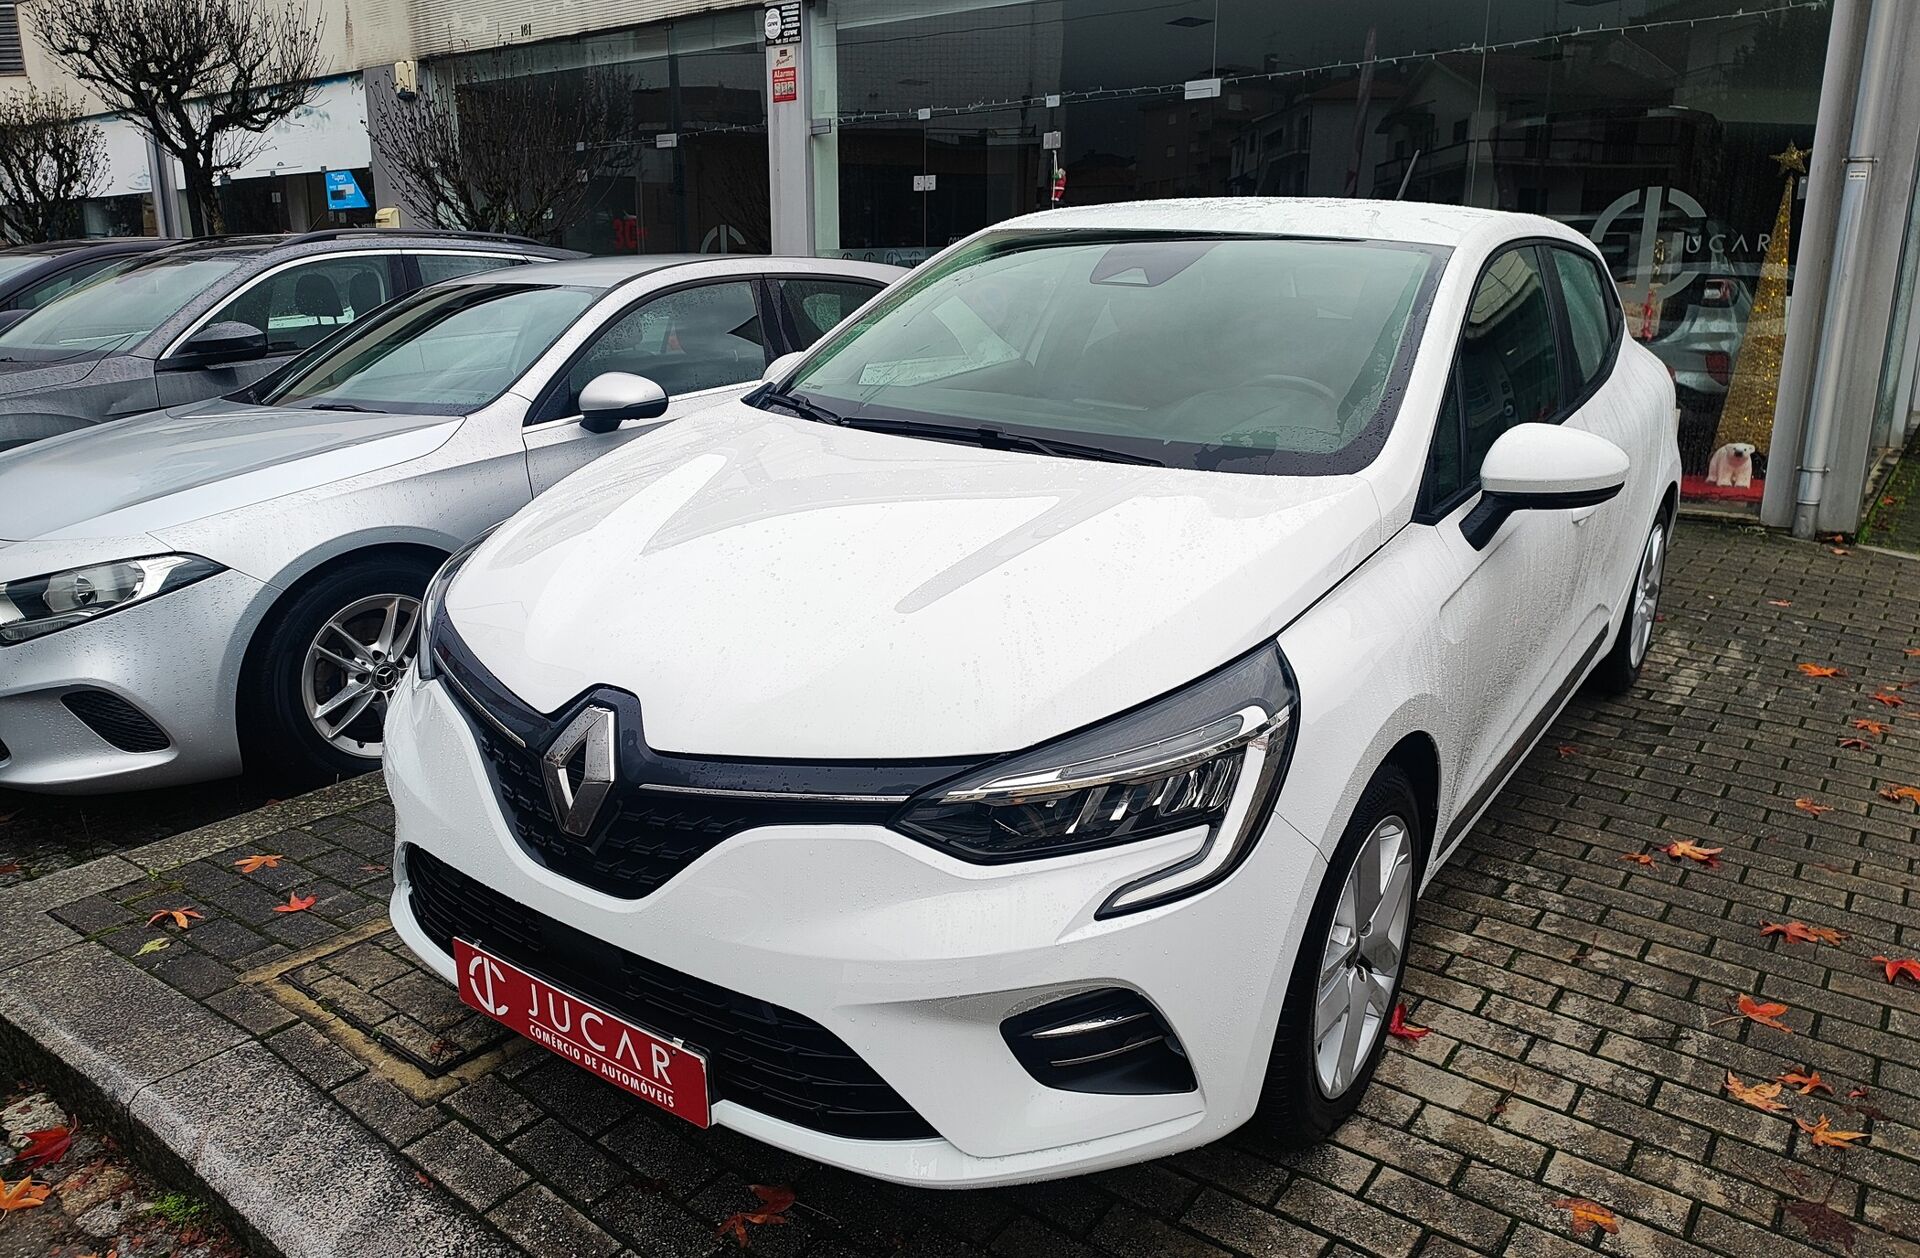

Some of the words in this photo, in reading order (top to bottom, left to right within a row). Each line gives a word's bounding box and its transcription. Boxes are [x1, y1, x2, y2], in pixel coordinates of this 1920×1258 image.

[528, 983, 673, 1086] JUCAR
[529, 1024, 580, 1061] COMÉRCIO
[584, 1053, 598, 1070] DE
[601, 1065, 675, 1109] AUTOMÓVEIS
